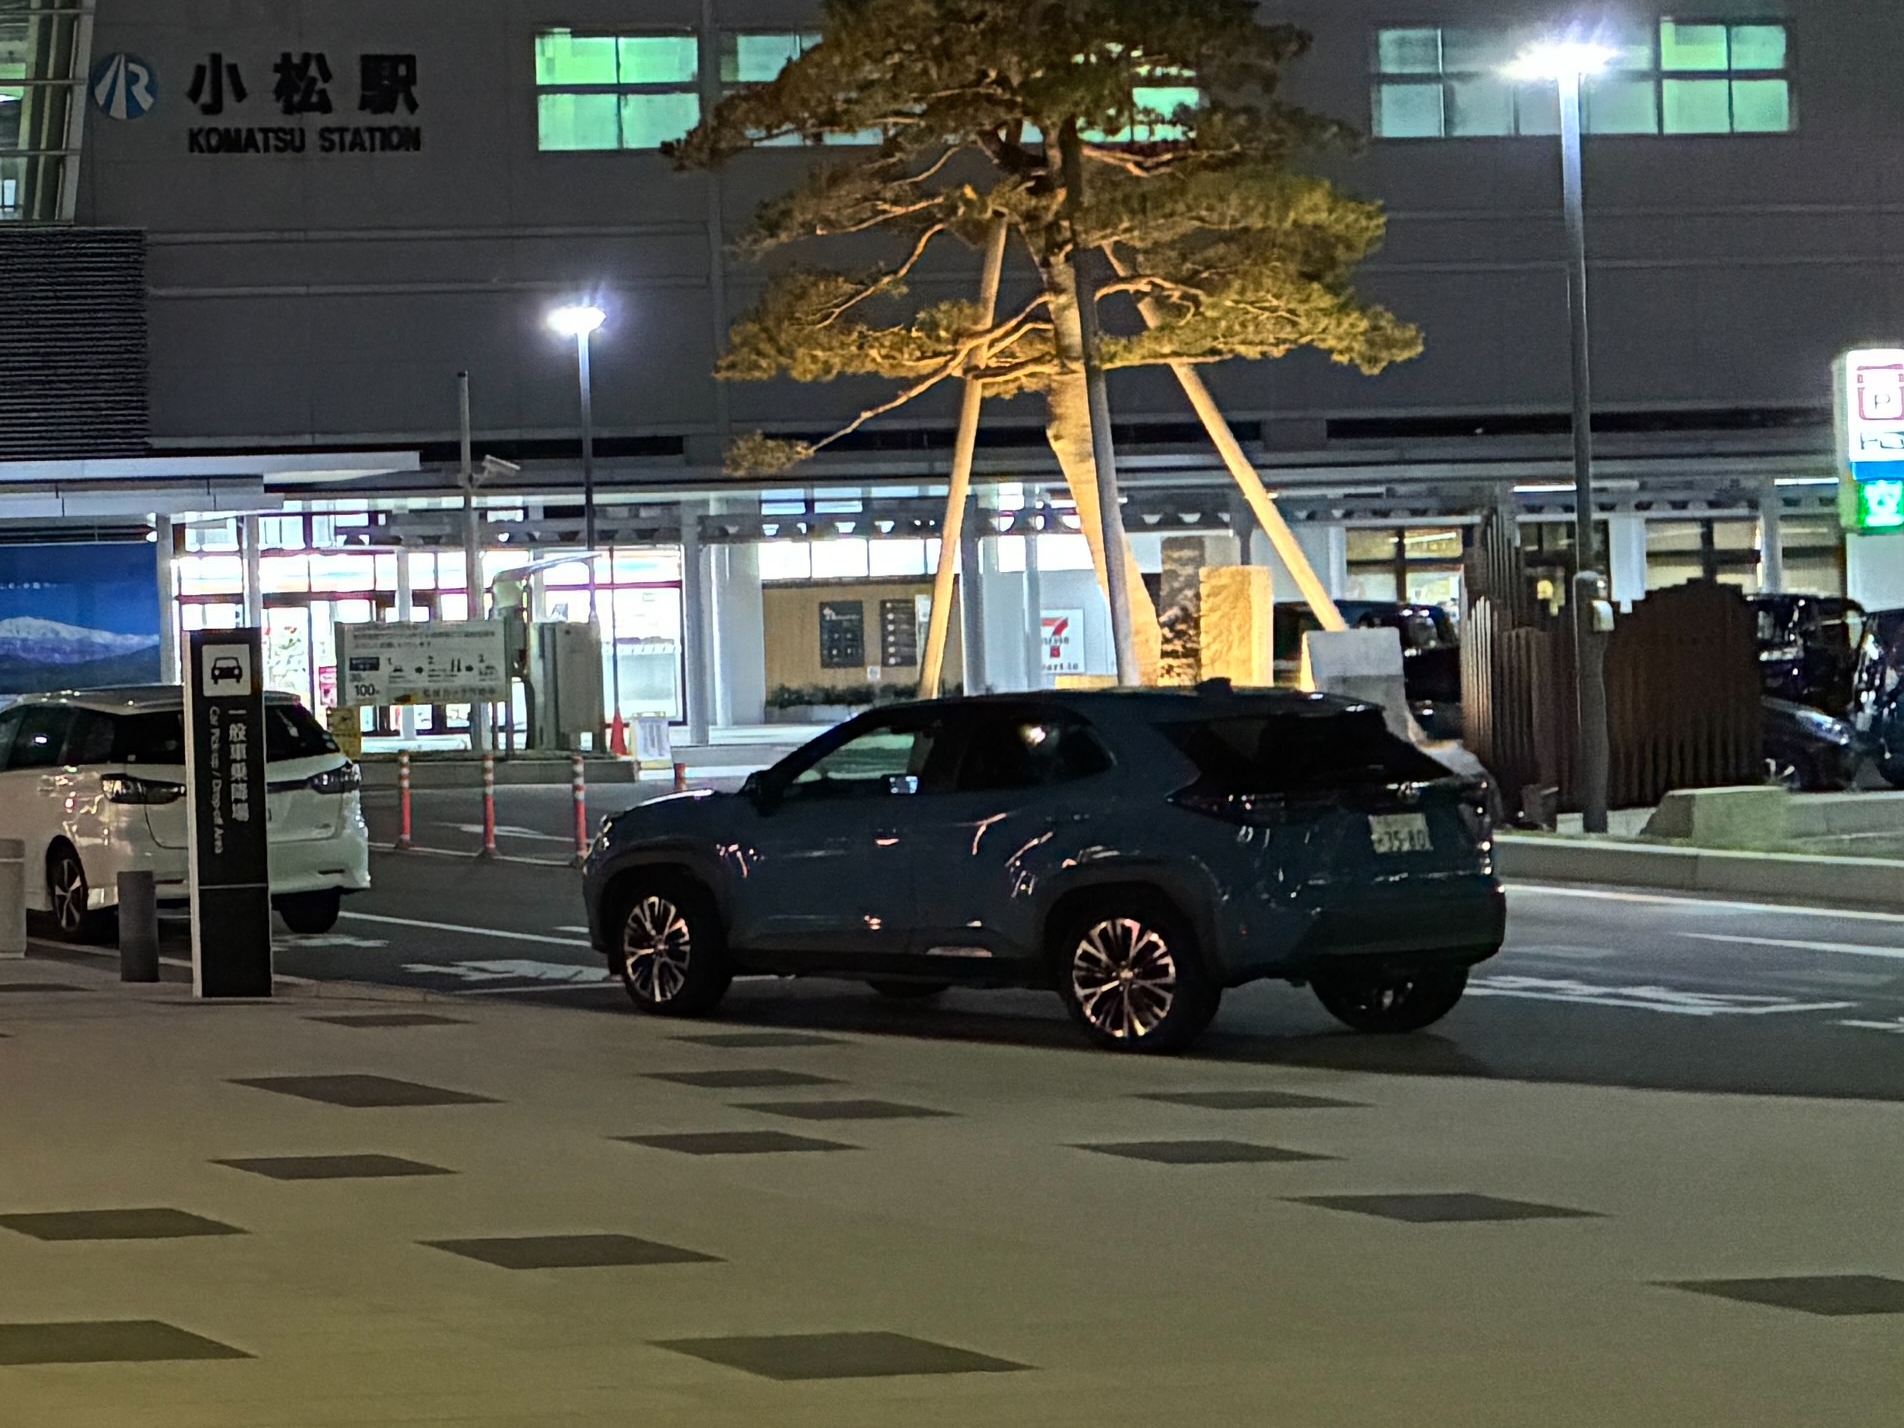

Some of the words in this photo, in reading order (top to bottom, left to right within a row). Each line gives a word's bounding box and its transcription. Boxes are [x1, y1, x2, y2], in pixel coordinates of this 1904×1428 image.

[186, 51, 420, 115] 小松駅
[187, 127, 306, 153] KOMATSU
[319, 126, 422, 153] STATION
